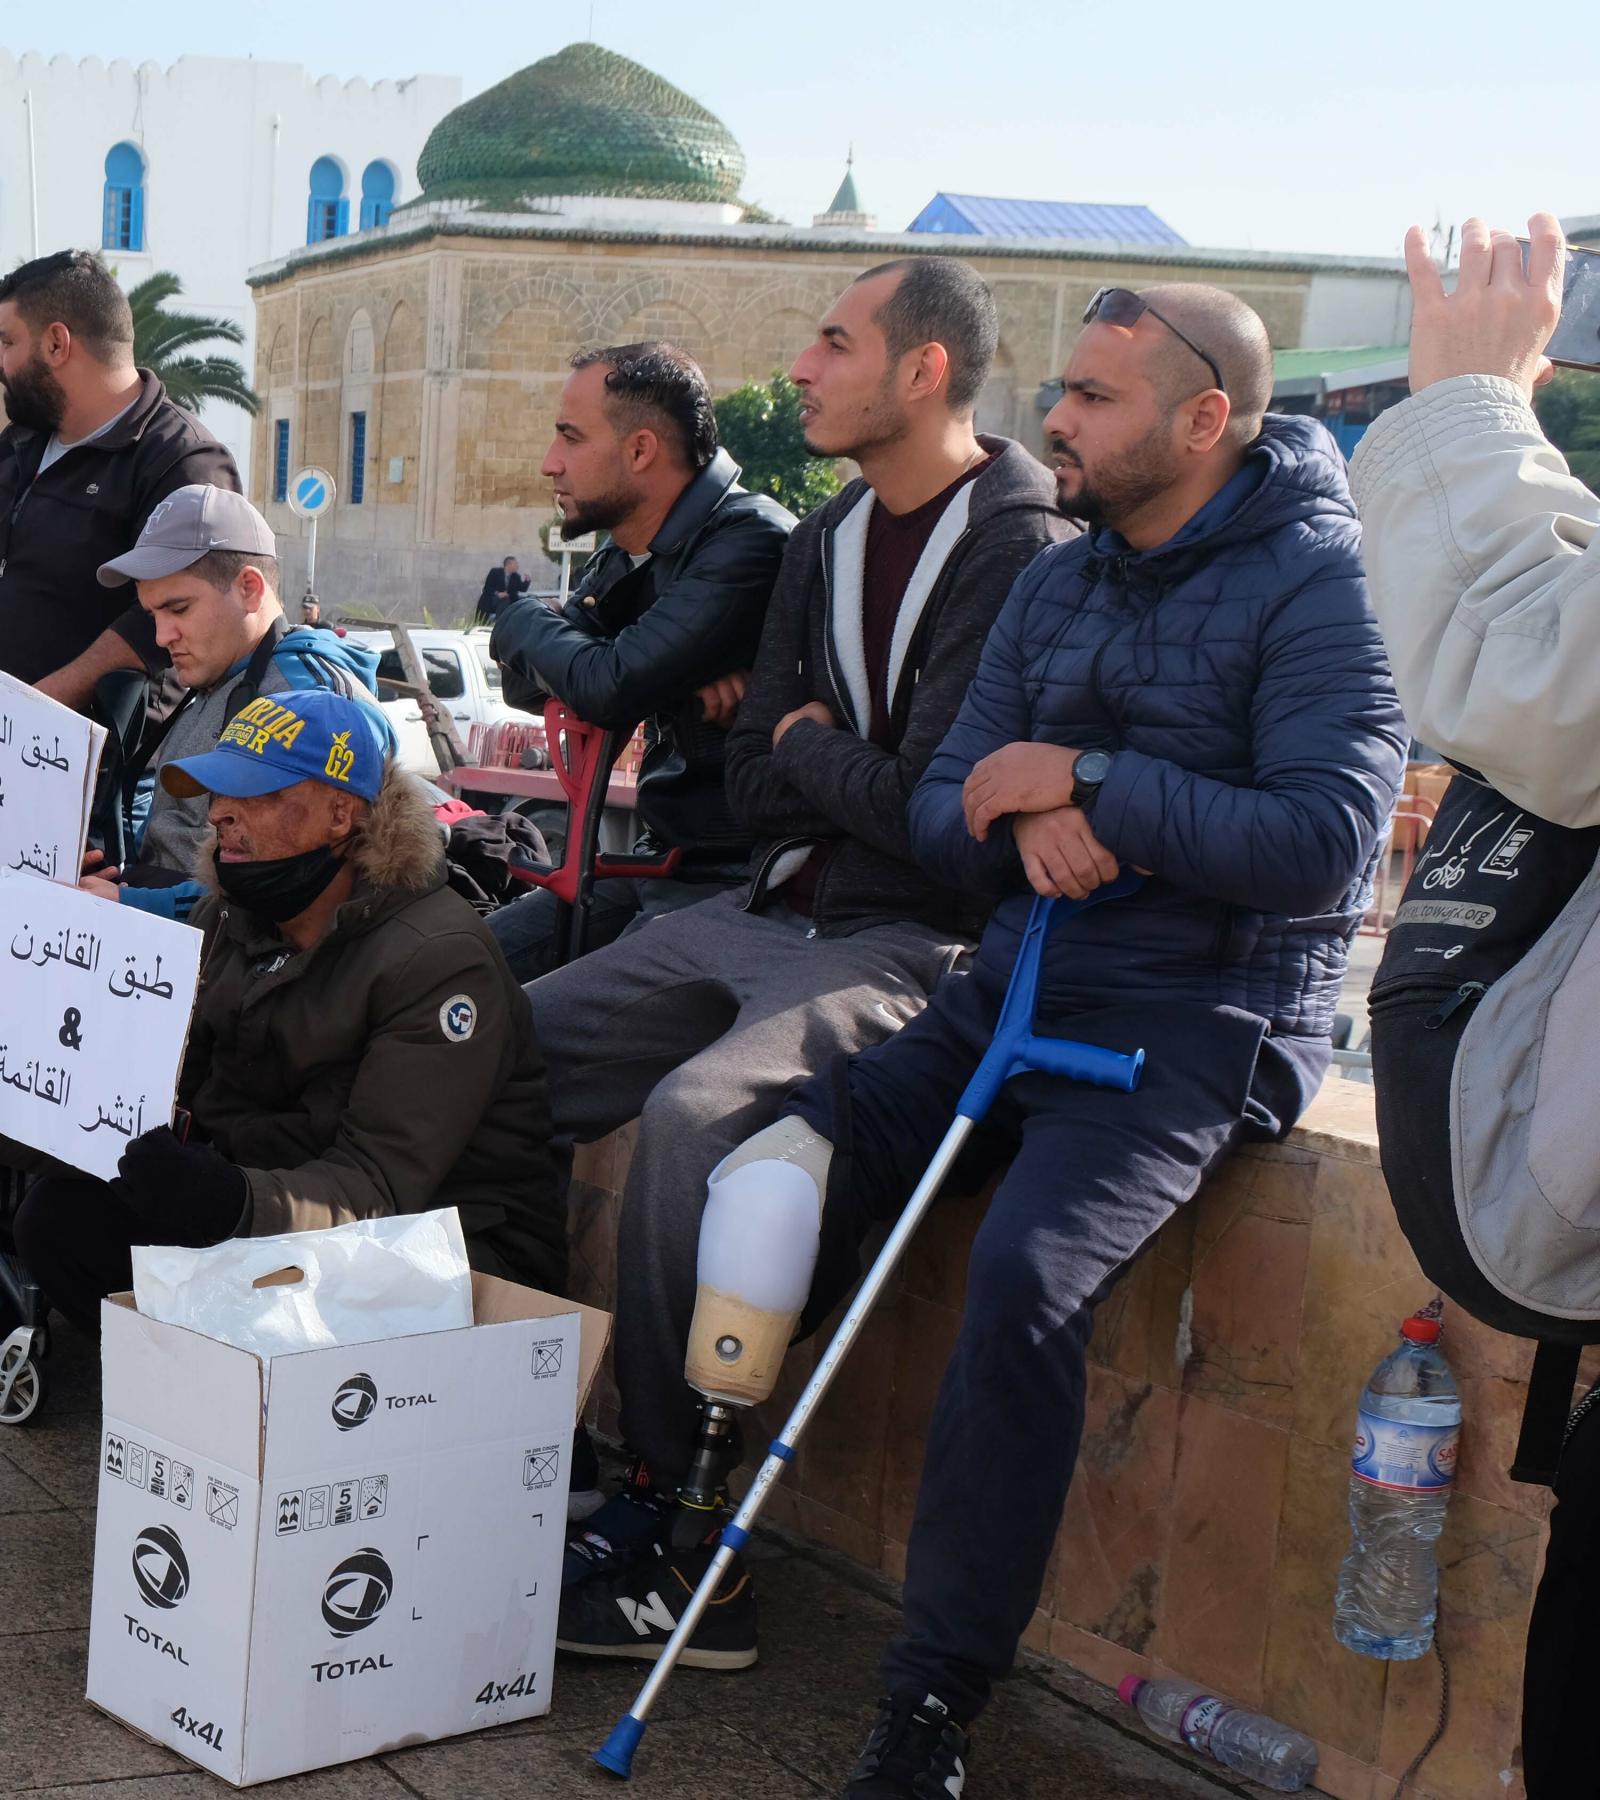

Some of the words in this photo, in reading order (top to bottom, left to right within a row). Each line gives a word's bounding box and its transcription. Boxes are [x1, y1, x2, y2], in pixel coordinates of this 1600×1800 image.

[21, 736, 69, 772] طبق
[324, 744, 355, 782] G2
[7, 843, 58, 879] أنشر
[10, 923, 101, 973] القانون
[108, 955, 174, 1000] طبق
[58, 1006, 83, 1052] &
[78, 1095, 146, 1138] أنشر
[385, 1391, 438, 1409] TOTAL
[154, 1460, 164, 1478] 5
[339, 1488, 351, 1505] 5
[124, 1614, 189, 1666] TOTAL
[311, 1653, 393, 1683] TOTAL
[476, 1672, 537, 1705] 4x4L
[171, 1707, 223, 1752] 4x4L
